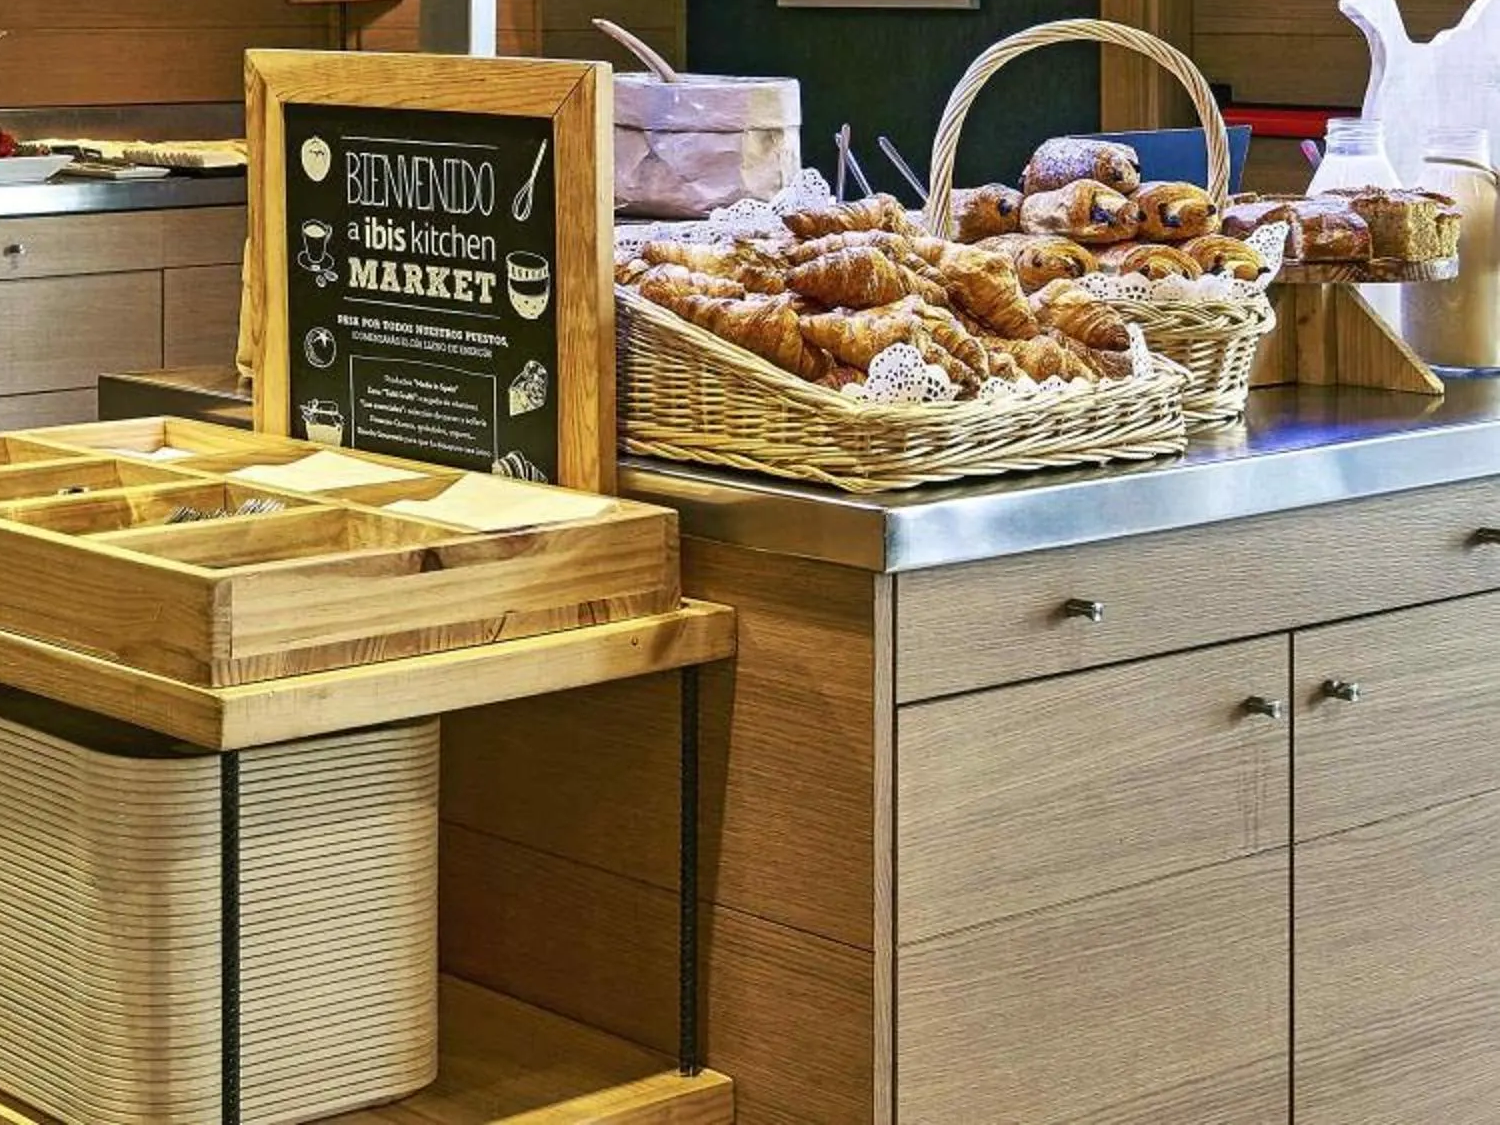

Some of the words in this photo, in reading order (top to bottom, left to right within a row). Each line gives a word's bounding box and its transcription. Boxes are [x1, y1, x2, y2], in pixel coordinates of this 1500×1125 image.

[345, 151, 495, 217] BIENVENIDO
[347, 221, 360, 240] a
[364, 216, 407, 252] ibis
[411, 220, 496, 262] kitchen
[348, 256, 497, 304] MARKET
